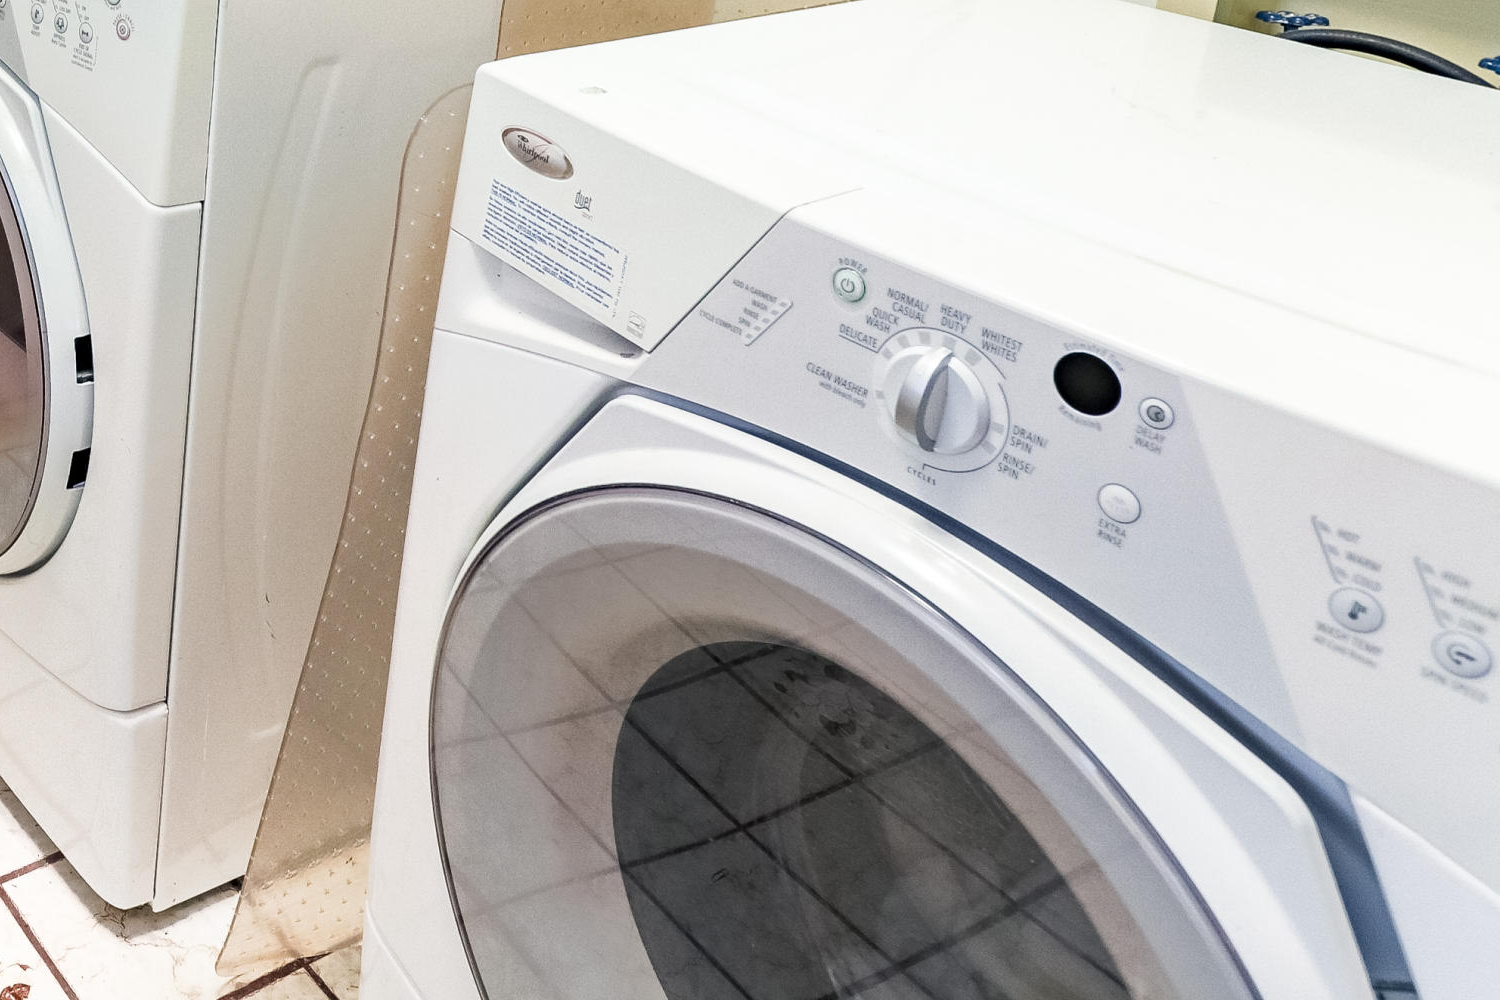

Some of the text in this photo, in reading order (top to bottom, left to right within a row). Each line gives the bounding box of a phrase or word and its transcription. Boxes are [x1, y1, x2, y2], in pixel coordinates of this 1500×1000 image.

[517, 140, 550, 164] Whirlpool
[838, 257, 868, 275] POWER
[872, 306, 900, 326] QUICK
[892, 301, 926, 324] CASUAL
[940, 304, 972, 324] HEAVY
[866, 315, 891, 334] WASH
[941, 317, 968, 334] DUTY
[839, 323, 878, 349] DELICATE
[981, 327, 1023, 352] WHITEST
[981, 340, 1017, 362] WHITES
[806, 361, 869, 399] CLEAN WASHER
[1010, 436, 1033, 454] SPIN
[907, 466, 936, 486] CYCLES
[997, 462, 1019, 480] SPIN
[1098, 518, 1126, 538] EXTRA
